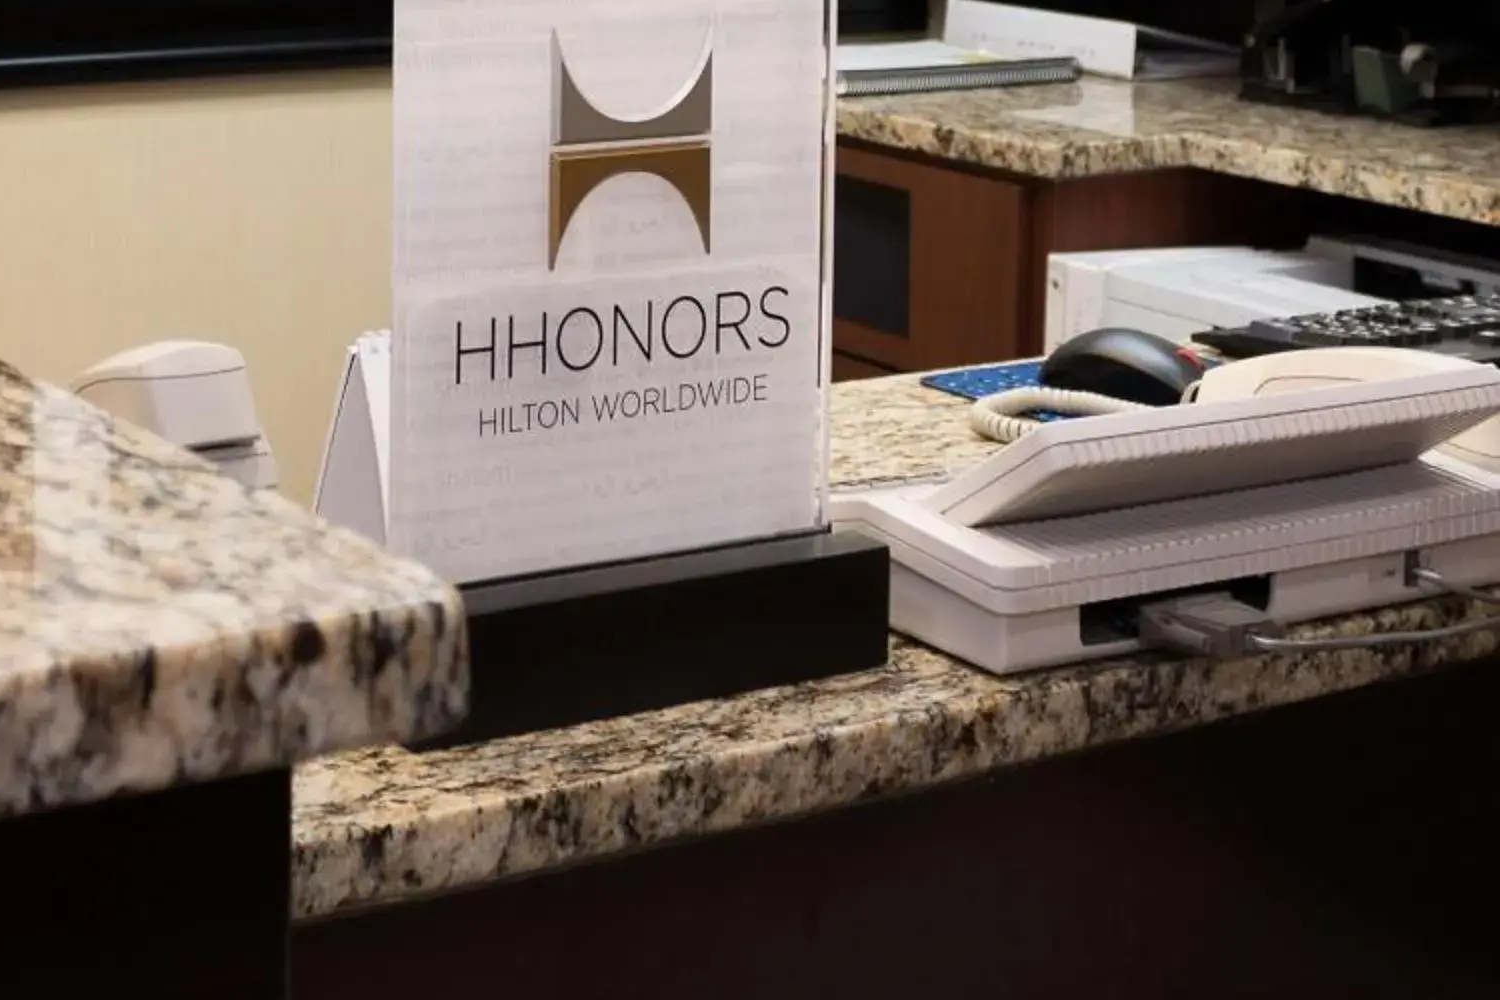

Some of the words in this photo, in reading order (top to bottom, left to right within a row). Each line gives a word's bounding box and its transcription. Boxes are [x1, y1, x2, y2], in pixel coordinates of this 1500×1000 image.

[455, 286, 790, 385] HHONORS
[478, 397, 582, 438] HILTON
[592, 374, 769, 422] WORLDWIDE
